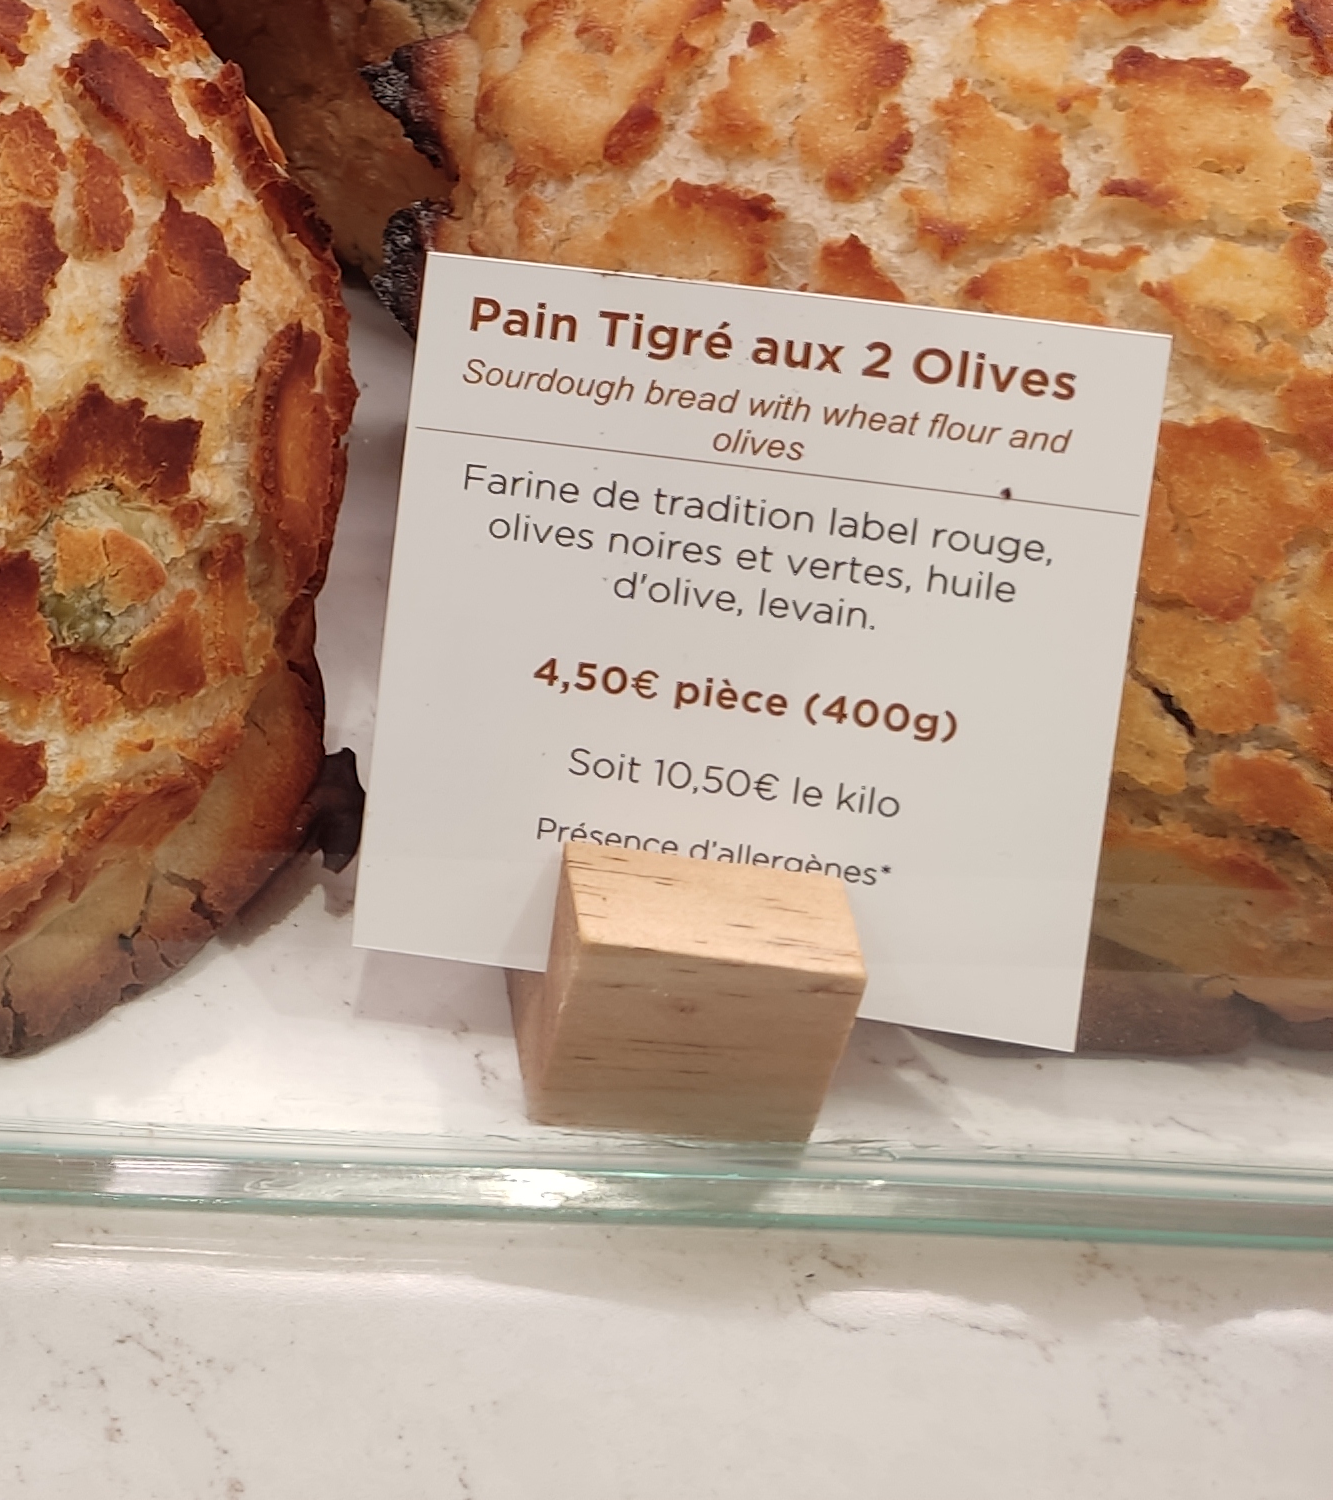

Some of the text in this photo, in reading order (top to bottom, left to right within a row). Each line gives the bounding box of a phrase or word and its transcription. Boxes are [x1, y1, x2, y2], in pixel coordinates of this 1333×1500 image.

[469, 296, 1078, 401] Pain Tigré aux 2 Olives
[462, 358, 1074, 454] Sourdough bread with wheat flour and
[712, 428, 805, 462] olives
[463, 463, 1053, 567] Farine de tradition label rouge,
[488, 512, 1017, 604] olives noires et vertes, huile
[613, 571, 876, 631] d'olive, levain.
[533, 657, 958, 744] 4,50€ pièce (400g)
[568, 747, 901, 818] Soit 10,50€ le kilo
[536, 817, 679, 855] Présence
